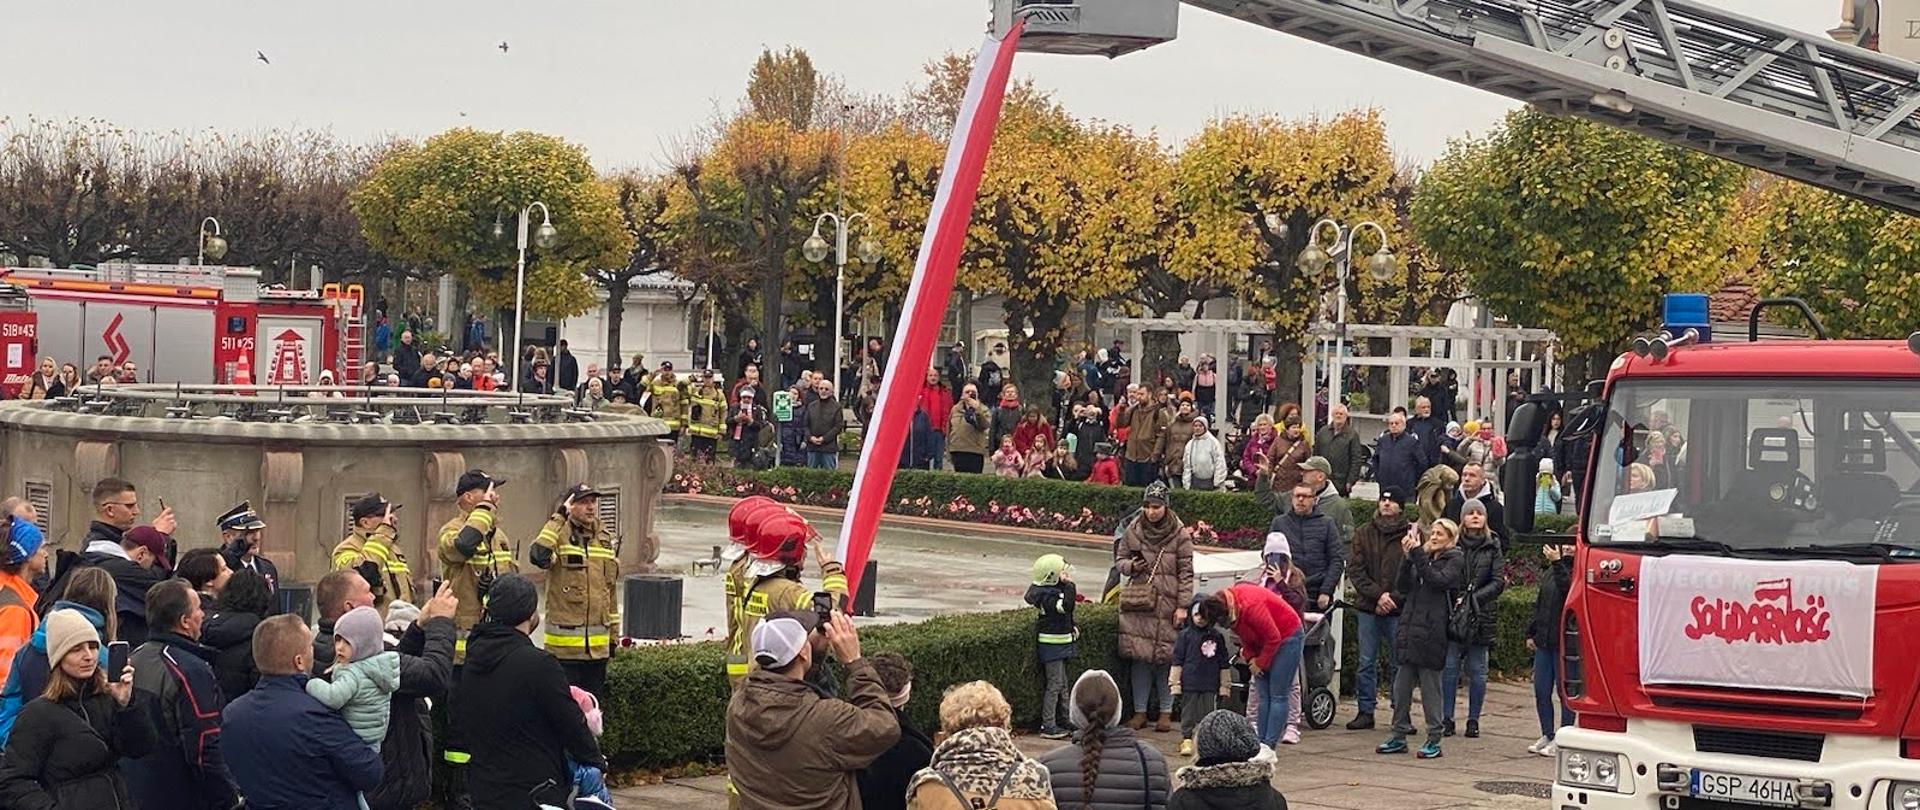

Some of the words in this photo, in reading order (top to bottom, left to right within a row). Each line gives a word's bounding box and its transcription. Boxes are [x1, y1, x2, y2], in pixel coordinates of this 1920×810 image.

[3, 324, 18, 337] 518
[23, 324, 35, 337] 43
[221, 336, 236, 350] 511
[1702, 774, 1742, 796] GSP
[1749, 779, 1794, 801] 46HA
